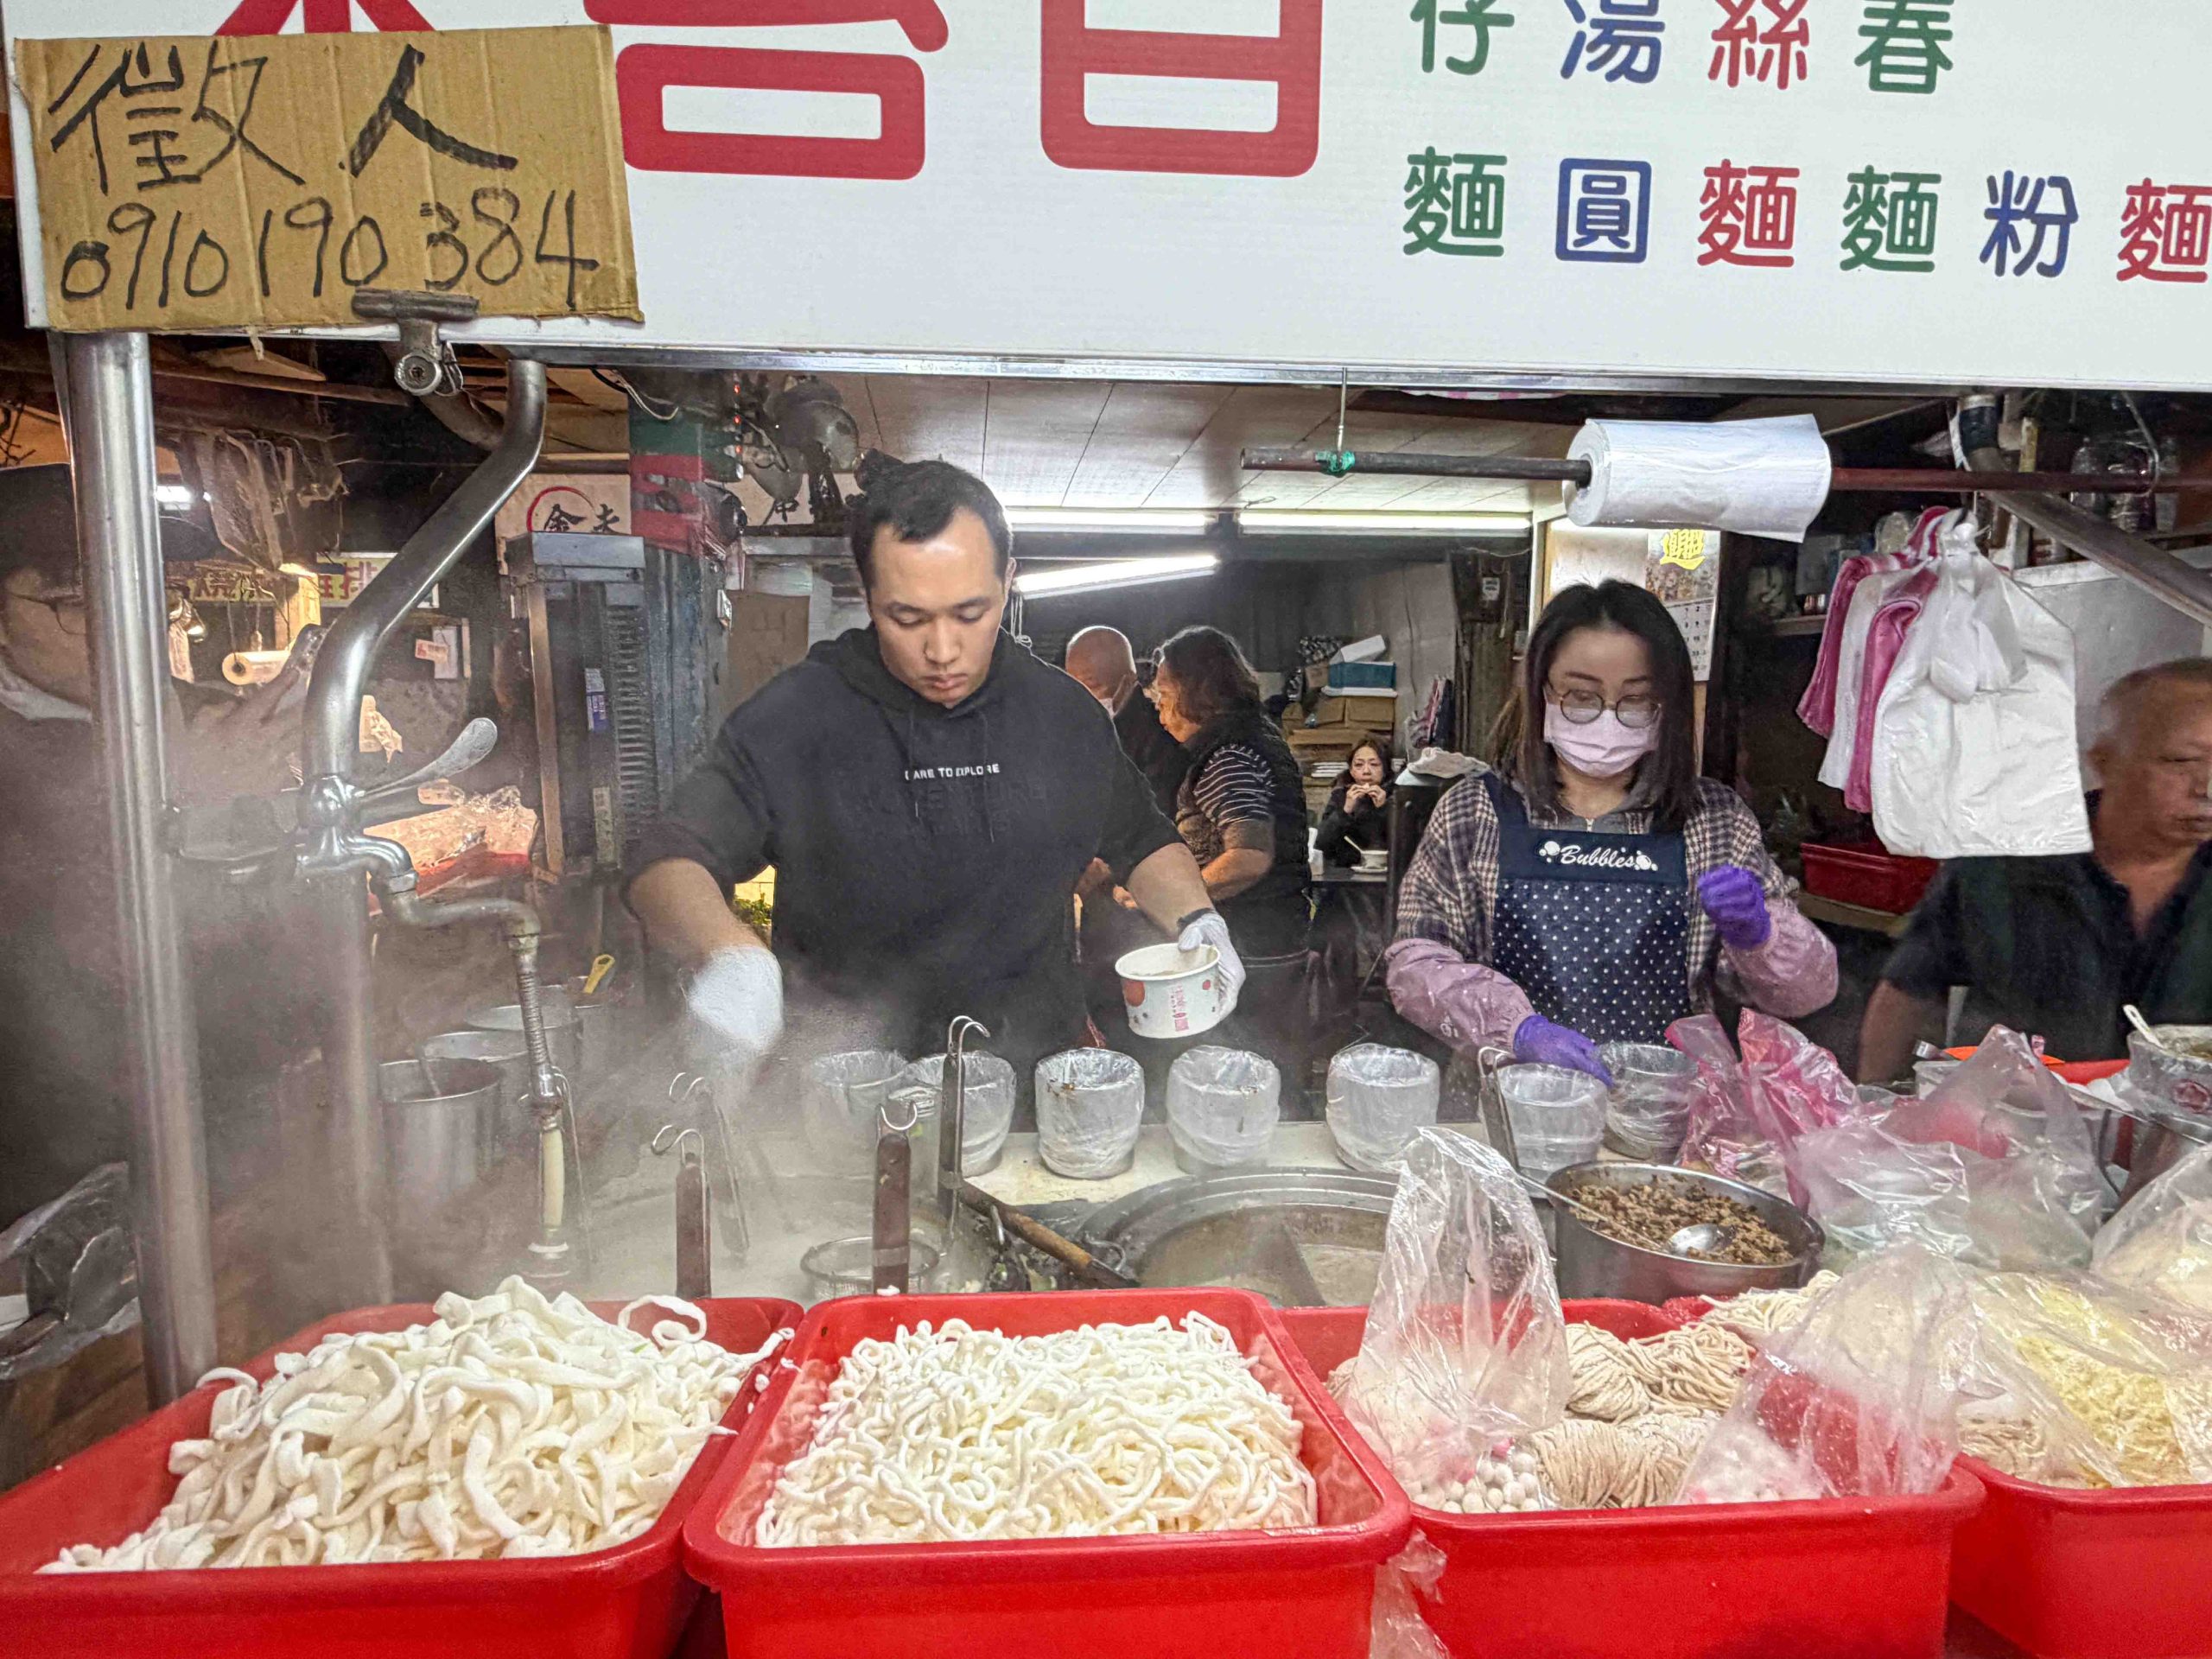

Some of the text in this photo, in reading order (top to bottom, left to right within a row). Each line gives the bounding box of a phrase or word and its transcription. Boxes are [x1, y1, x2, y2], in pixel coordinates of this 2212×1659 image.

[48, 41, 518, 194] 徵人
[938, 766, 953, 779] TO
[1560, 844, 1636, 868] Bubbles
